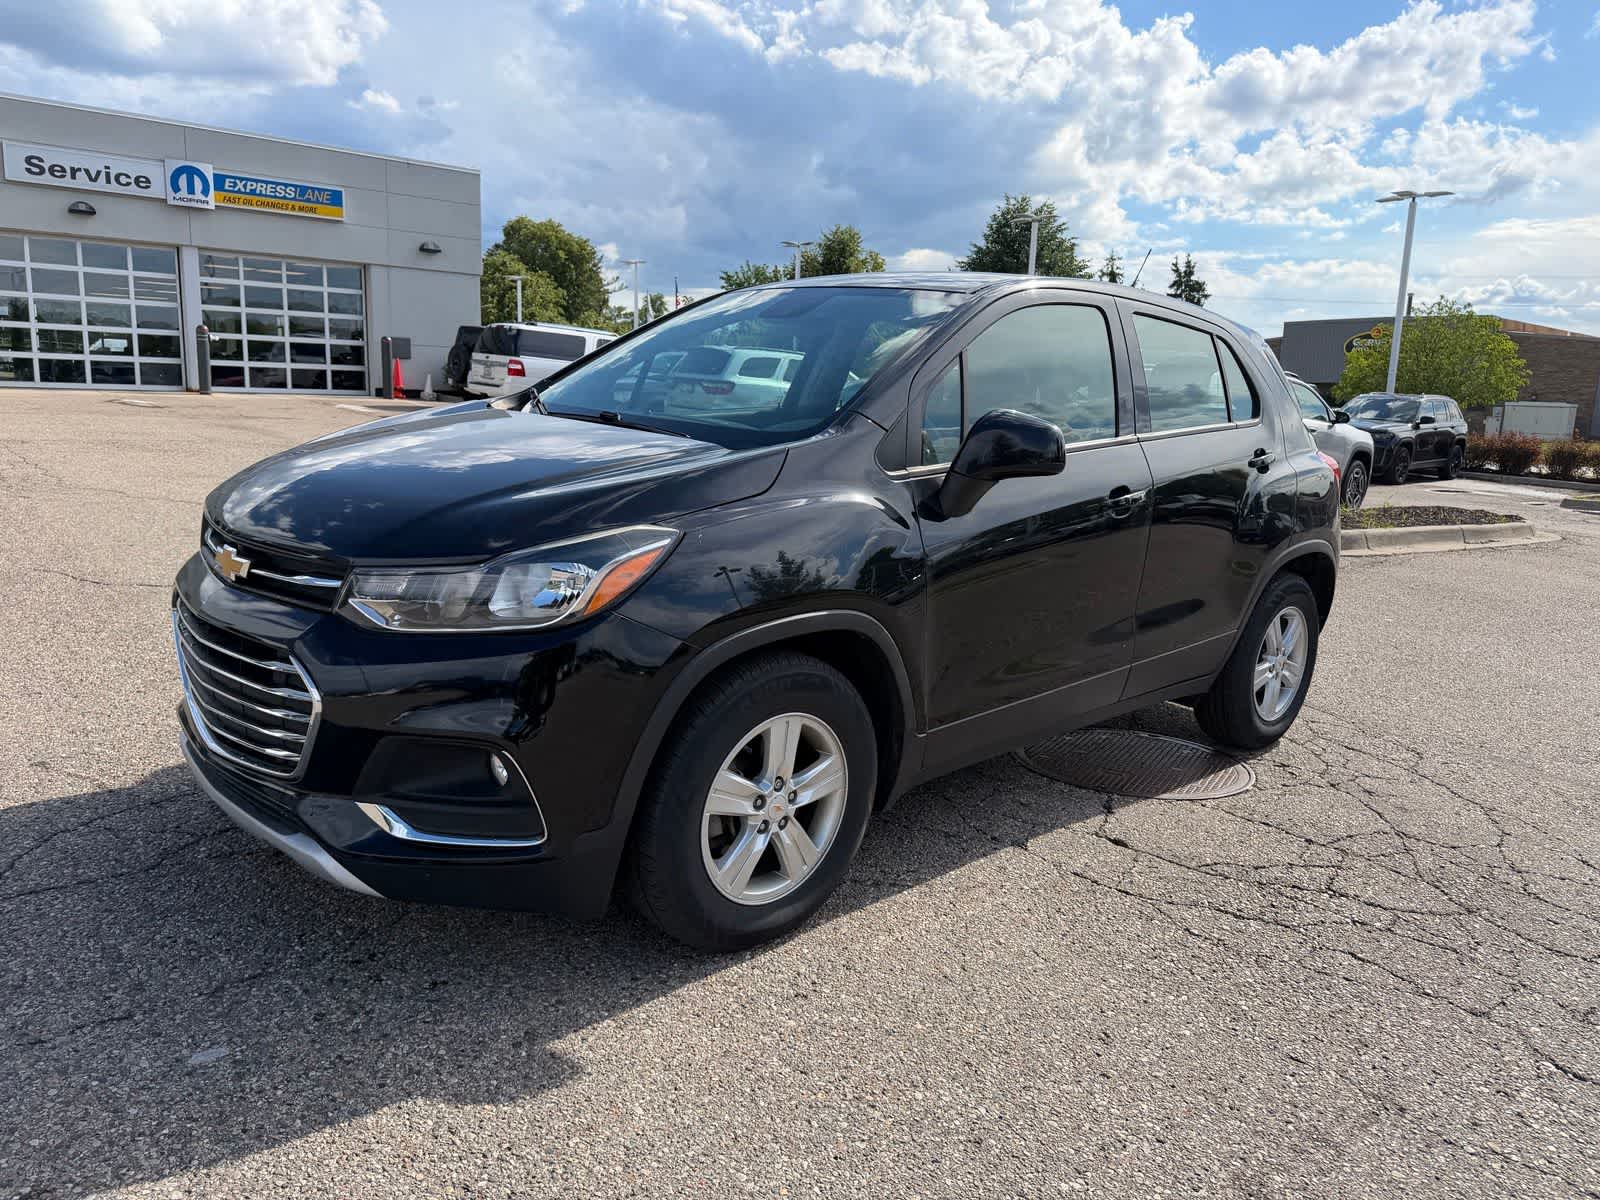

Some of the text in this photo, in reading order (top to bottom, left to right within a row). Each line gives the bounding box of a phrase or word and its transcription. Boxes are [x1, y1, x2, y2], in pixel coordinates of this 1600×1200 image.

[24, 154, 152, 190] Service
[172, 195, 209, 205] MOPAR
[222, 195, 318, 215] FAST OIL CHANGES & MORE
